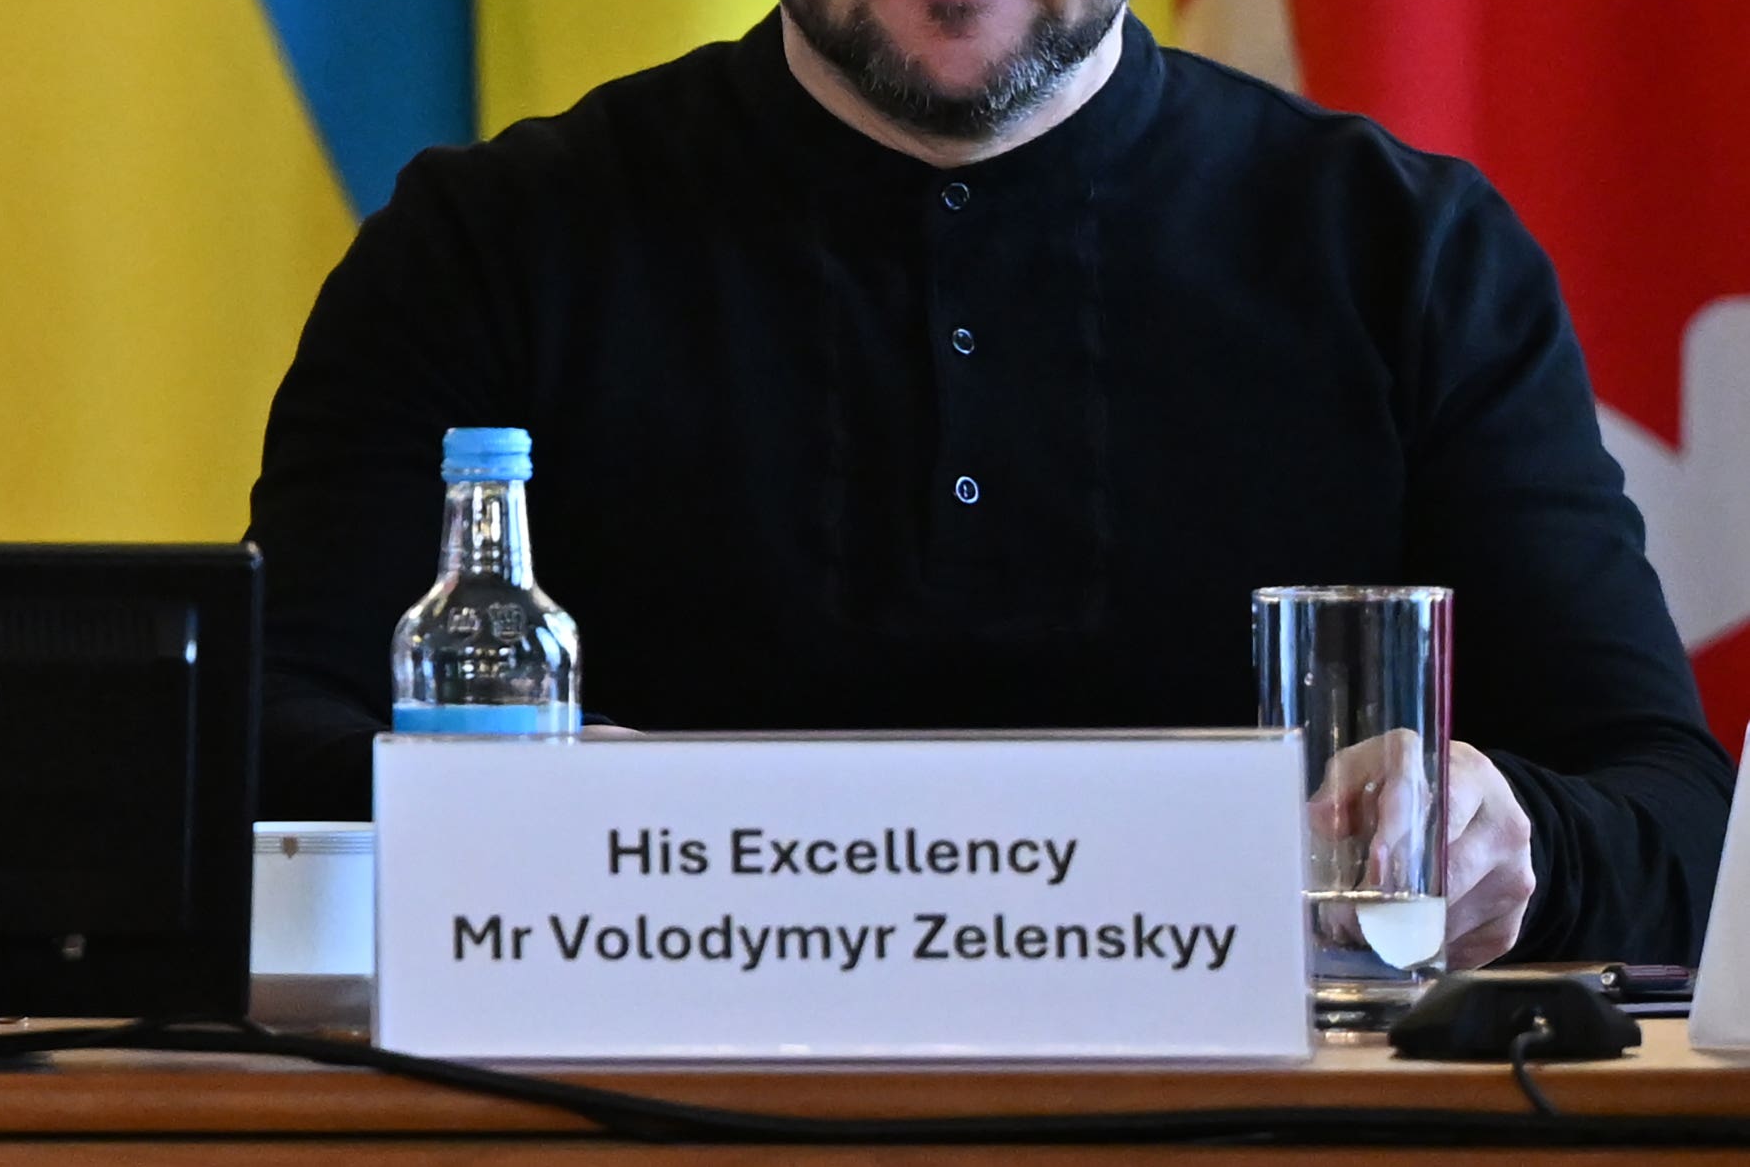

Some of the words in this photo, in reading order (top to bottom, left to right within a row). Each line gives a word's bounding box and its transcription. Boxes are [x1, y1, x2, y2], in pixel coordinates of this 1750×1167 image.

[608, 828, 709, 876] His
[730, 827, 1077, 886] Excellency
[453, 914, 533, 962] Mr
[548, 913, 897, 973] Volodymyr
[913, 912, 1237, 972] Zelenskyy
